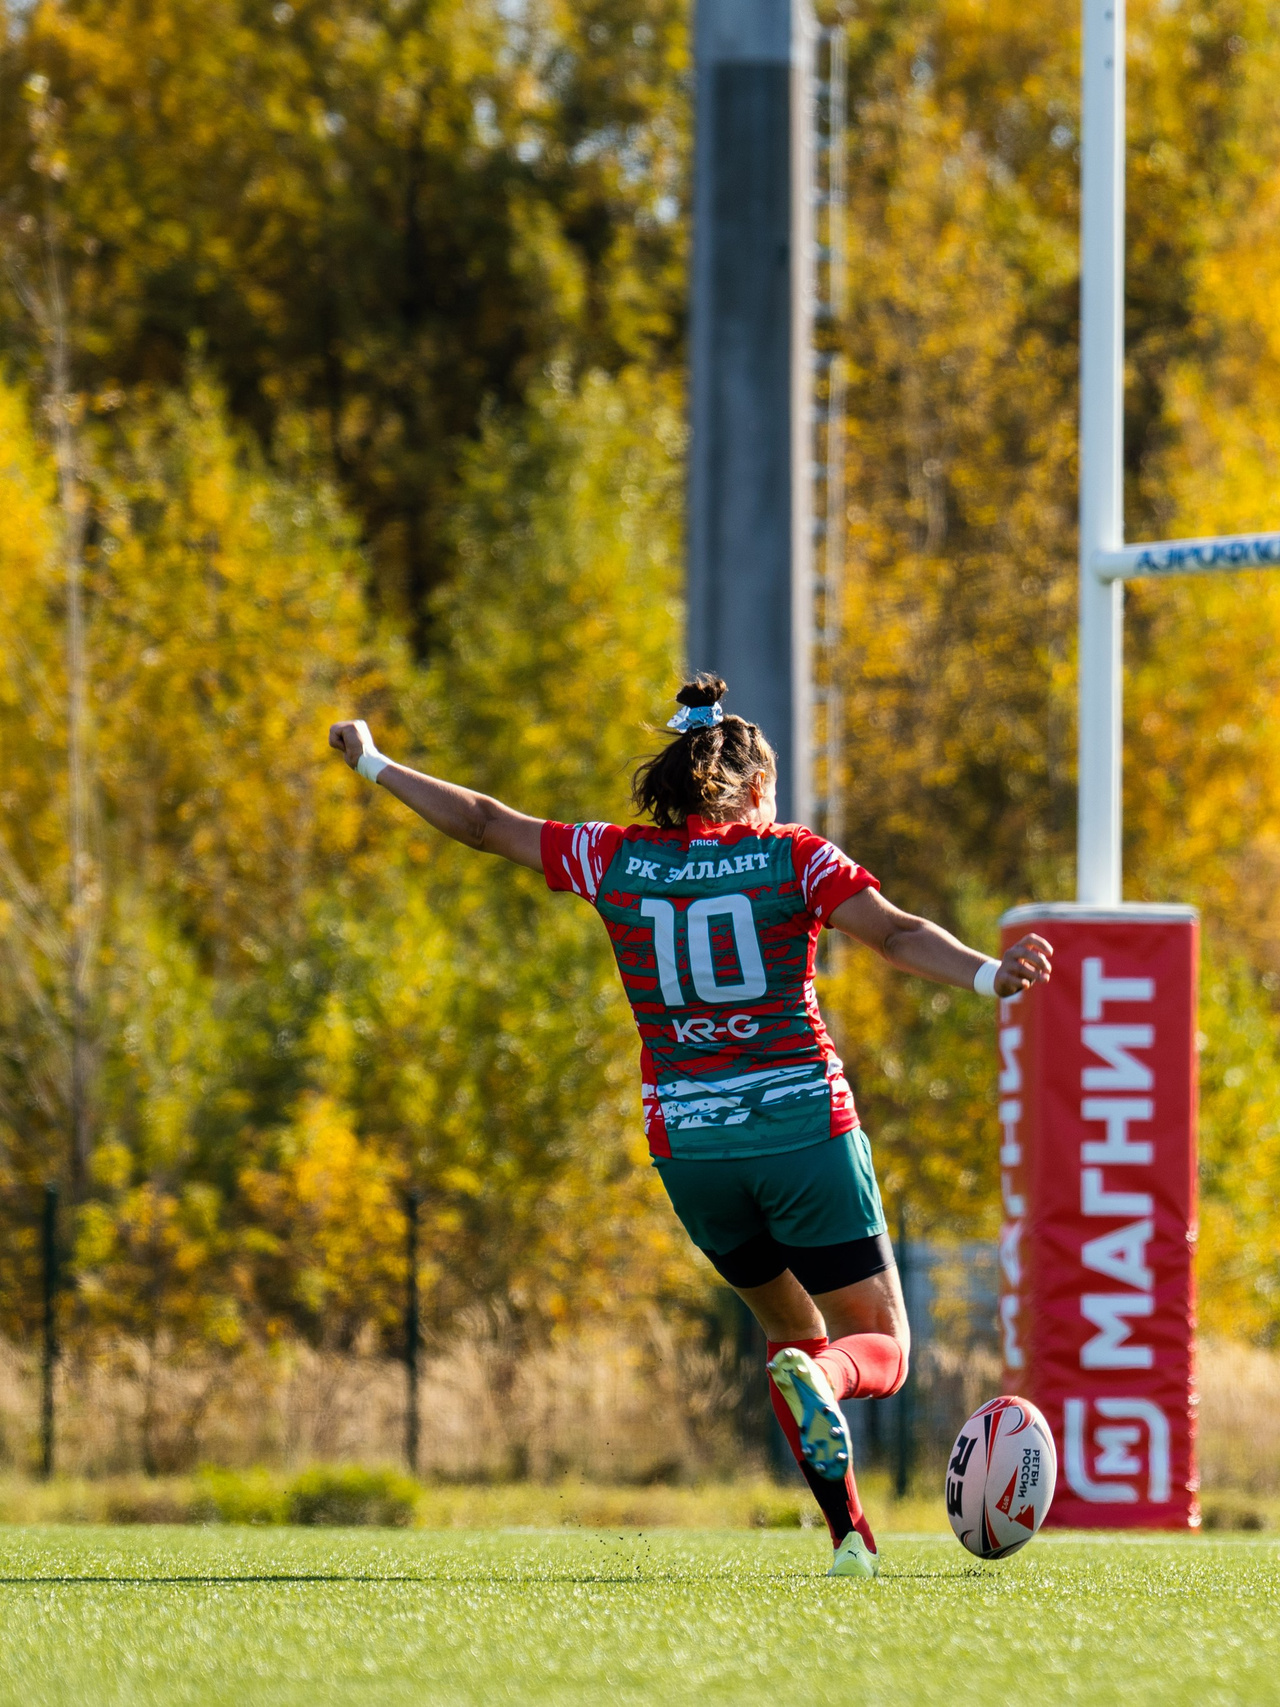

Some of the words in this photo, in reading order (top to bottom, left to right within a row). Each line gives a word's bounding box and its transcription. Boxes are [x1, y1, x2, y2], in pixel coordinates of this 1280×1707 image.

[625, 856, 661, 881] РК
[640, 893, 768, 1007] 10
[671, 1013, 760, 1043] KR-G
[1080, 957, 1155, 1370] МАГНИТ
[1017, 1448, 1031, 1498] РОССИИ
[1029, 1449, 1041, 1487] РЕГБИ
